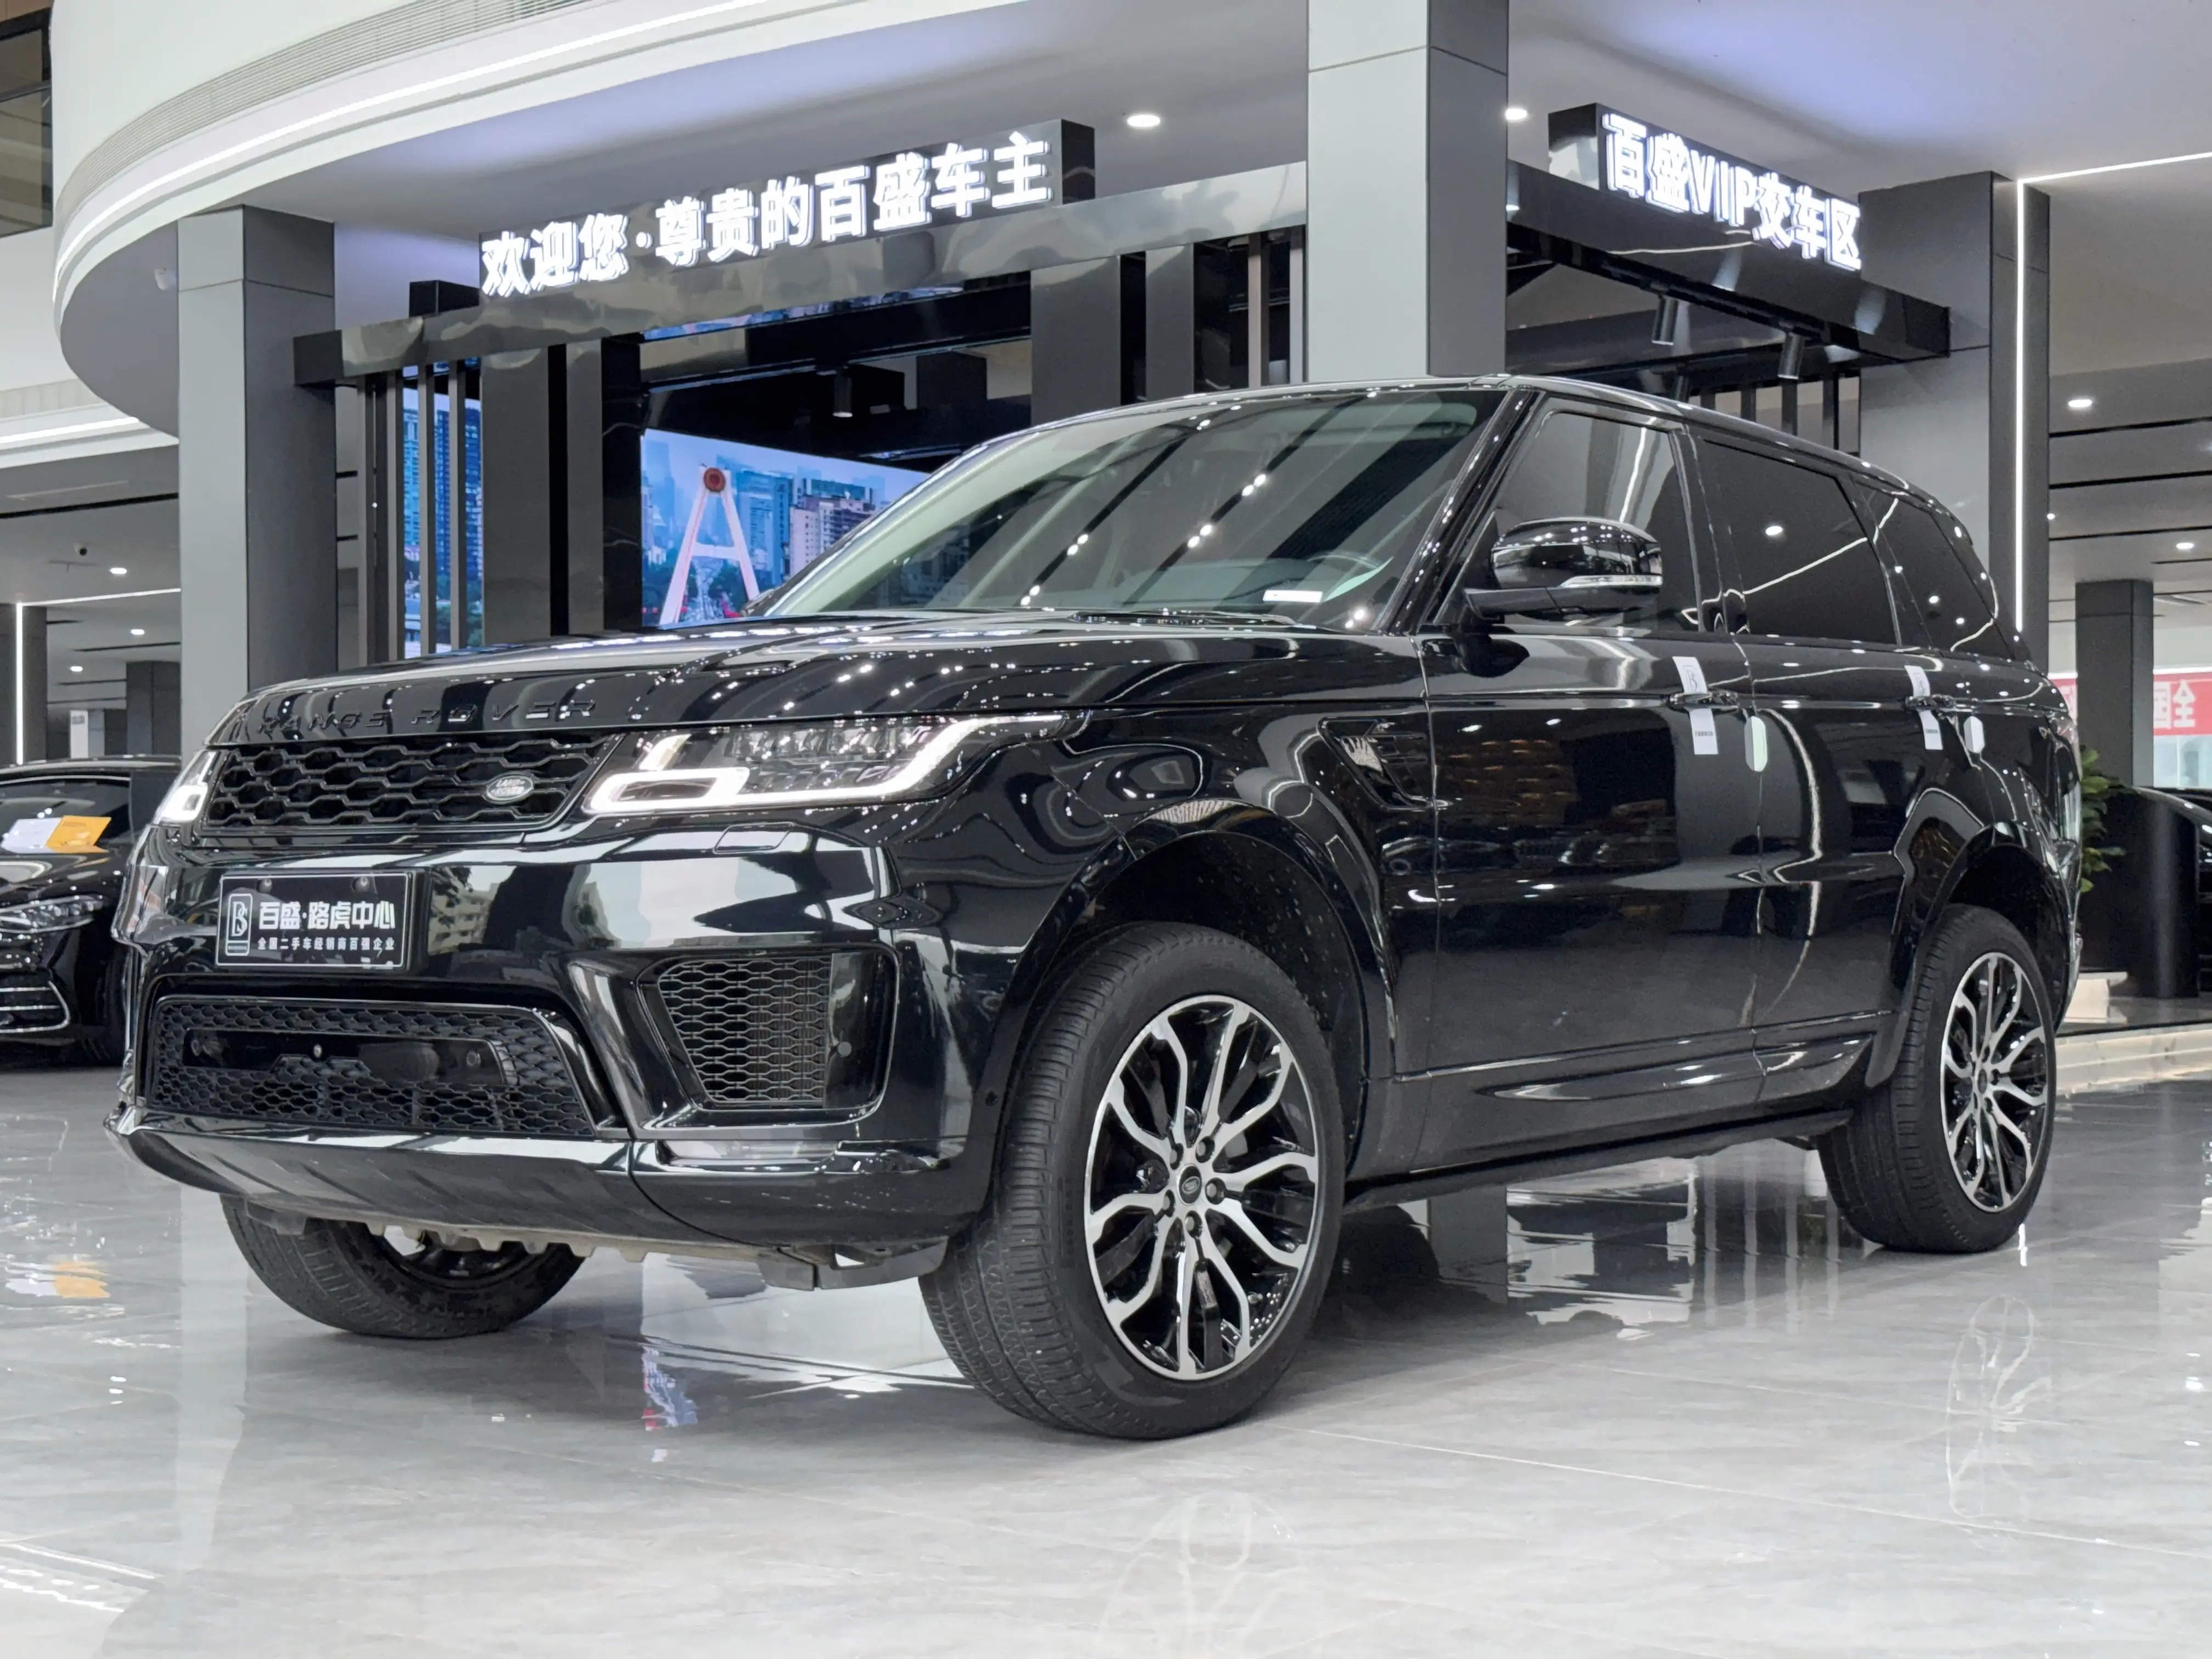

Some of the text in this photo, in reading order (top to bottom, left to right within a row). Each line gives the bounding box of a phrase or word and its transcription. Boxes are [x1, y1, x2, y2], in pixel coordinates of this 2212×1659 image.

[1602, 112, 1861, 271] 百盛VIP交车区
[481, 131, 1053, 297] 欢迎您·尊贵的百盛车主
[256, 698, 596, 736] RANGE ROVER
[258, 900, 396, 930] 百盛·路虎中心
[257, 936, 394, 951] 全国二手车经销商百强企业
